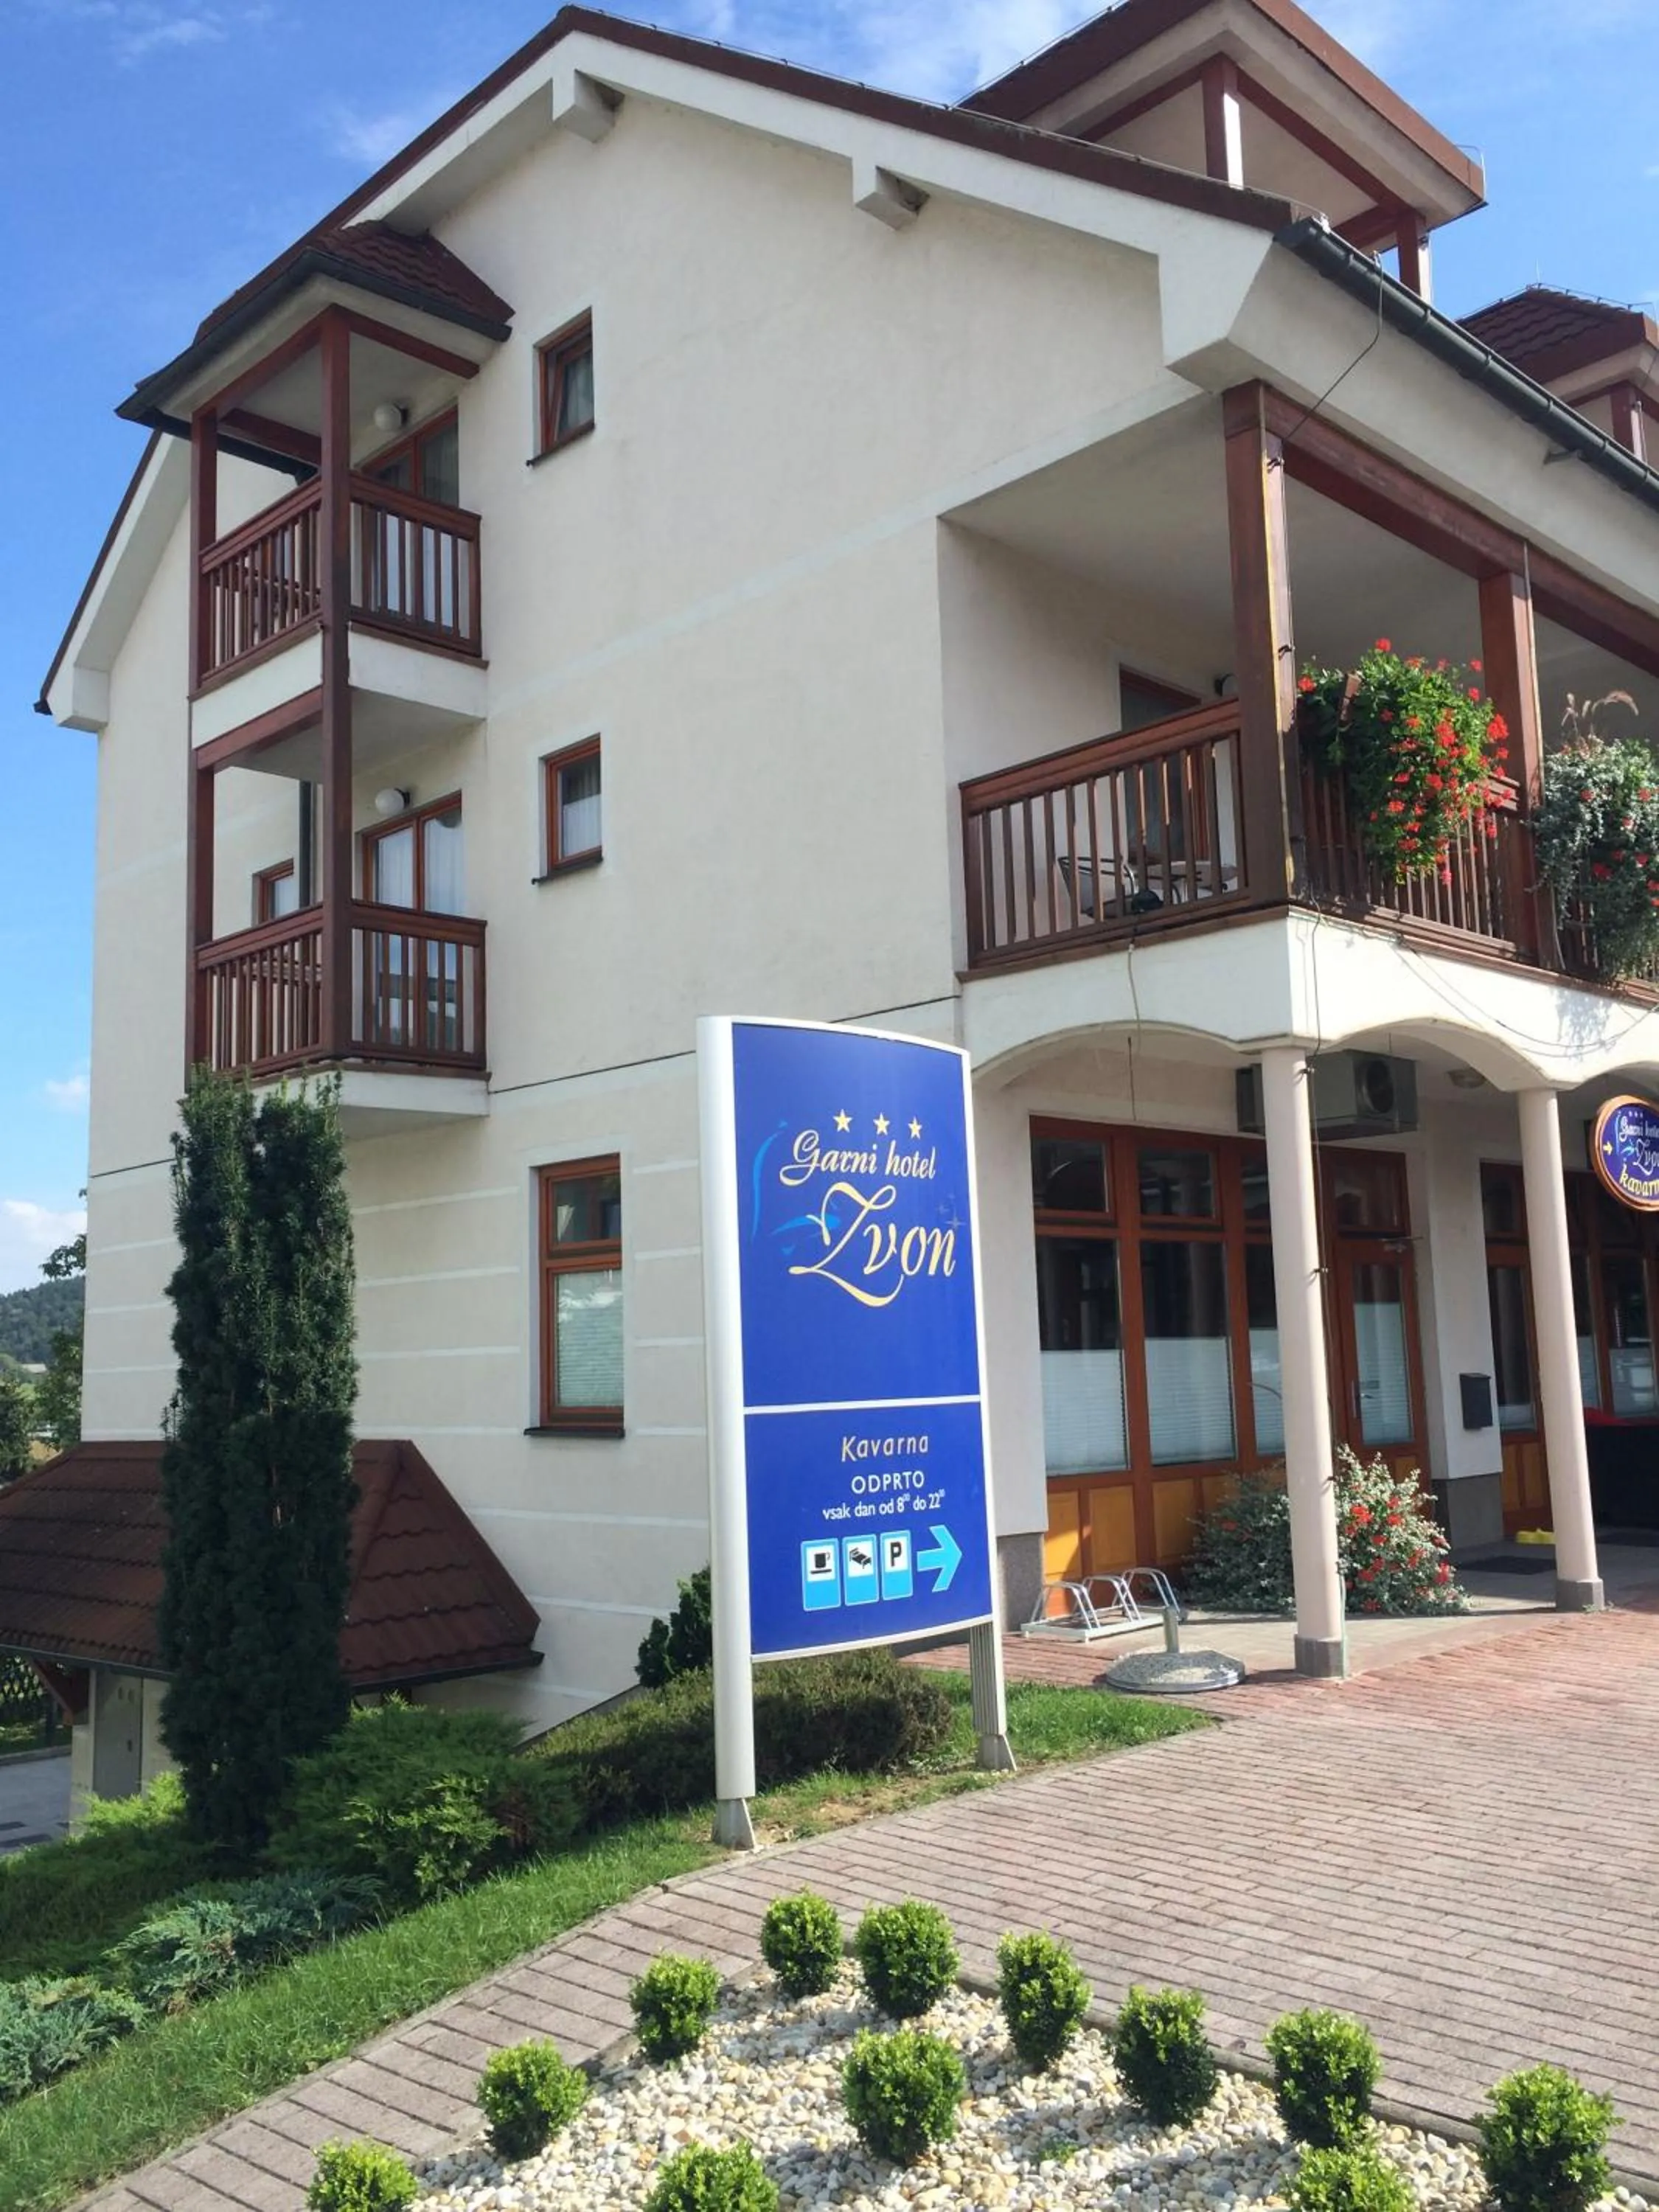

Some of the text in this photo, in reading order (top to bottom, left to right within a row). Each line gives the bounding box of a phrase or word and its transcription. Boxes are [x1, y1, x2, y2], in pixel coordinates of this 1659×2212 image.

[779, 1130, 936, 1186] Garni hotel
[788, 1181, 956, 1307] Zvon
[841, 1435, 929, 1462] Kavarna
[851, 1470, 925, 1494] ODPRTO
[822, 1502, 851, 1520] vsak
[854, 1501, 876, 1517] dan
[878, 1498, 894, 1515] od
[913, 1495, 925, 1511] do
[889, 1541, 902, 1568] P
